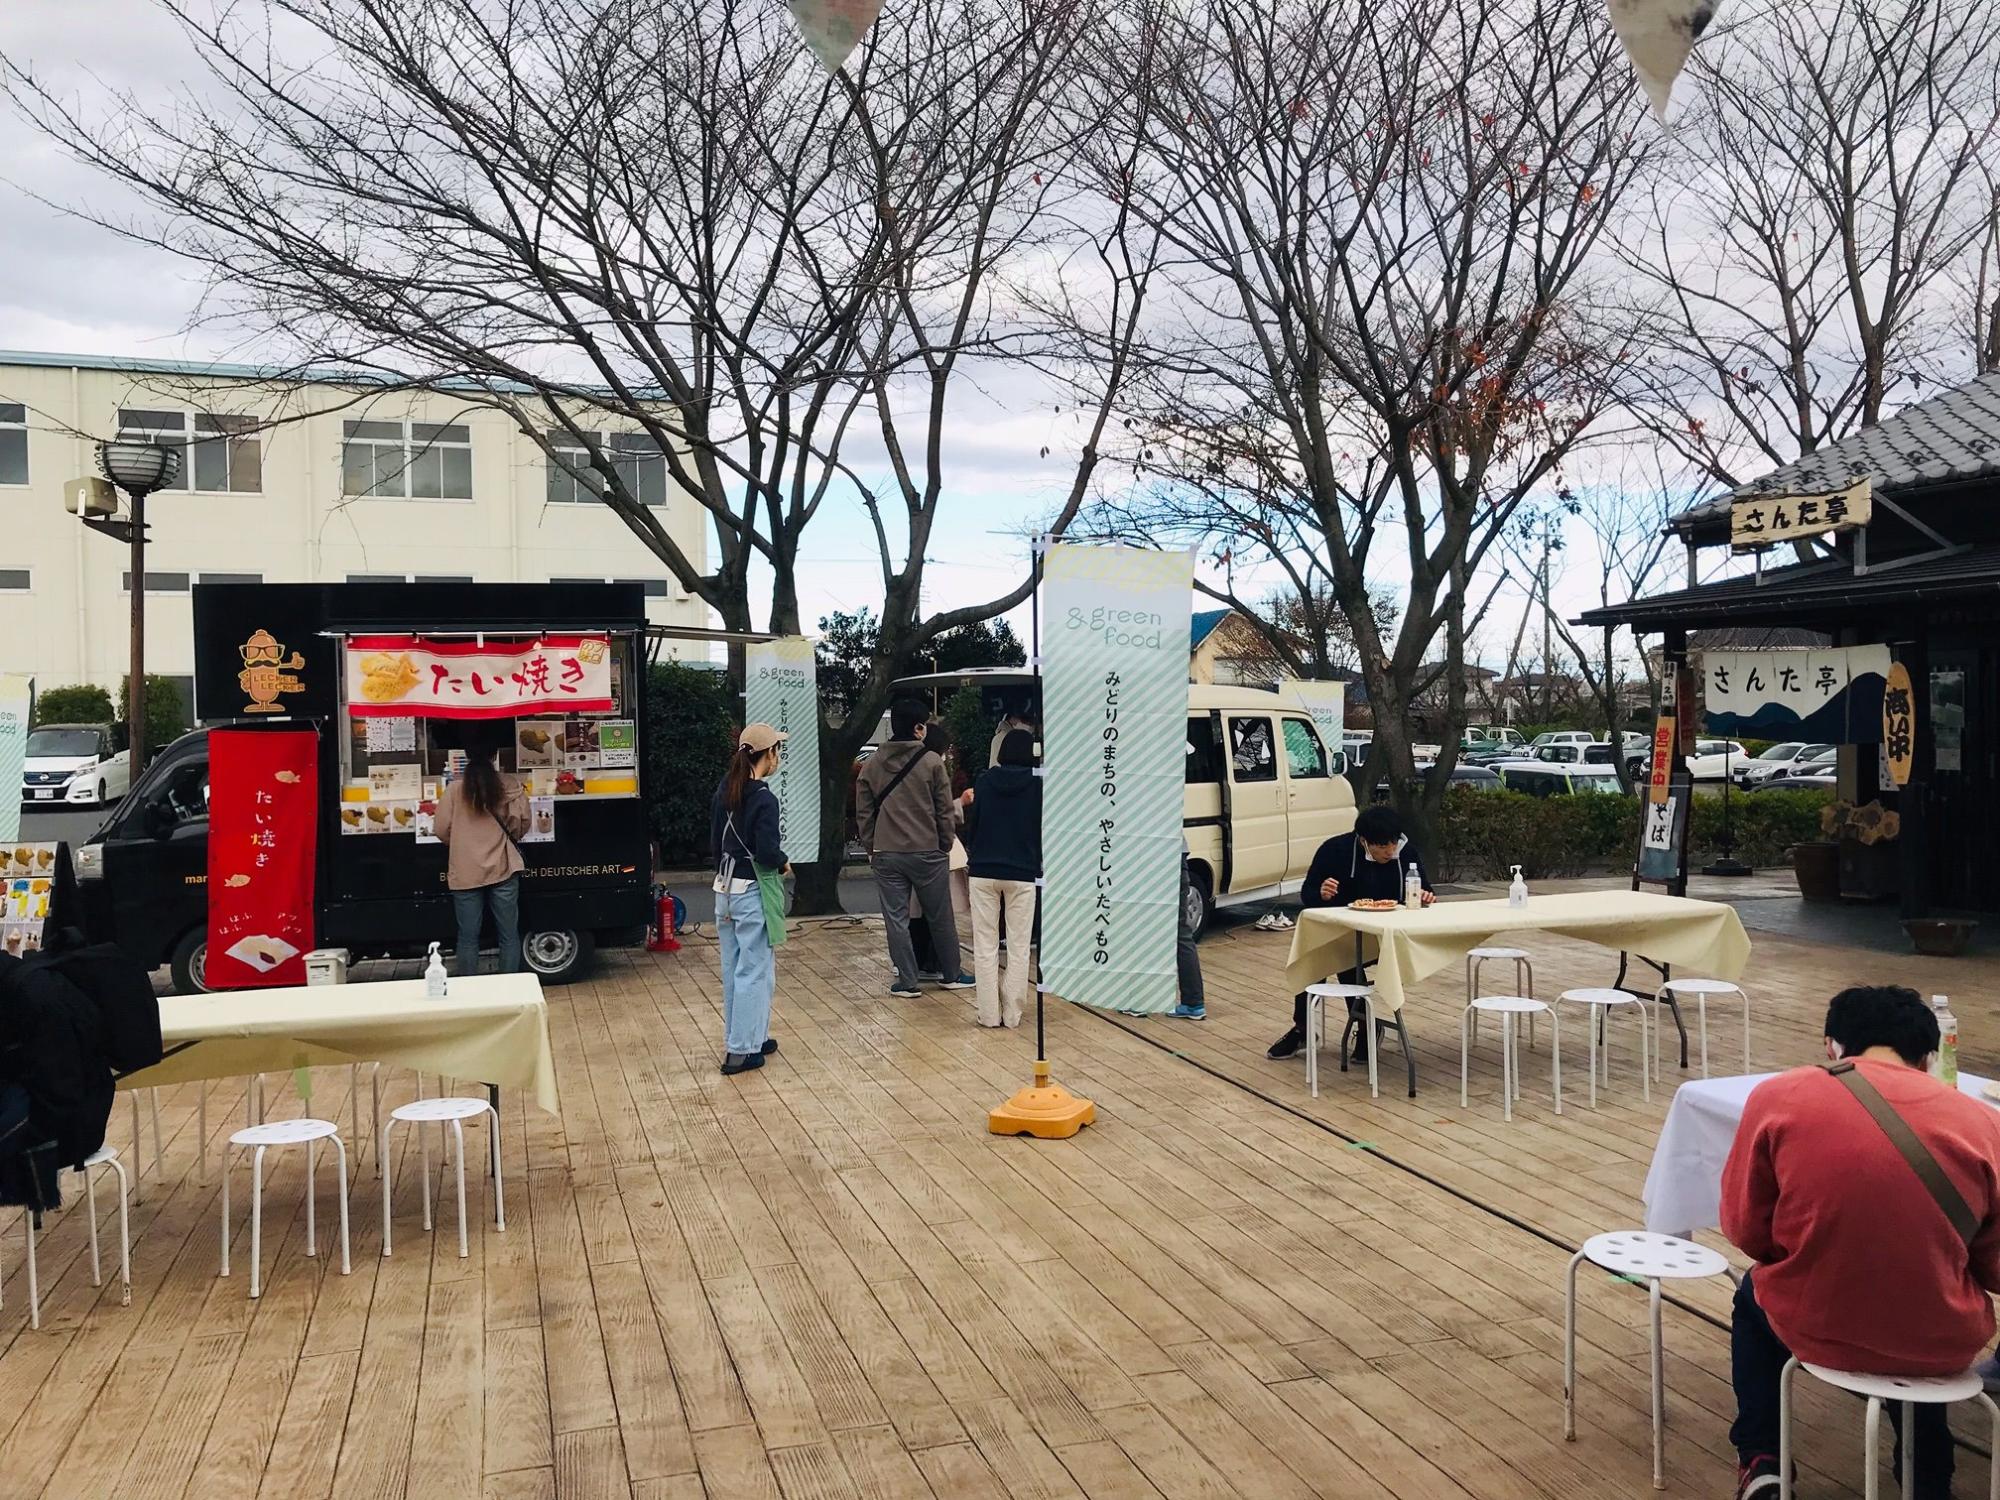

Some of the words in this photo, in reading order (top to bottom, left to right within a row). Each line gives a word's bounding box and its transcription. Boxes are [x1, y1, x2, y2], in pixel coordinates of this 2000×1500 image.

[1745, 495, 1849, 533] さんた亭
[1103, 625, 1161, 650] food
[430, 654, 585, 697] たい焼き
[778, 677, 805, 688] food
[1713, 665, 1837, 696] さんた亭
[1652, 727, 1671, 786] 営業中
[250, 790, 276, 868] たい焼き
[1093, 670, 1121, 965] みどりのまちの、やさしいたべもの
[540, 866, 599, 878] DEUTSCHER
[601, 864, 621, 875] ART
